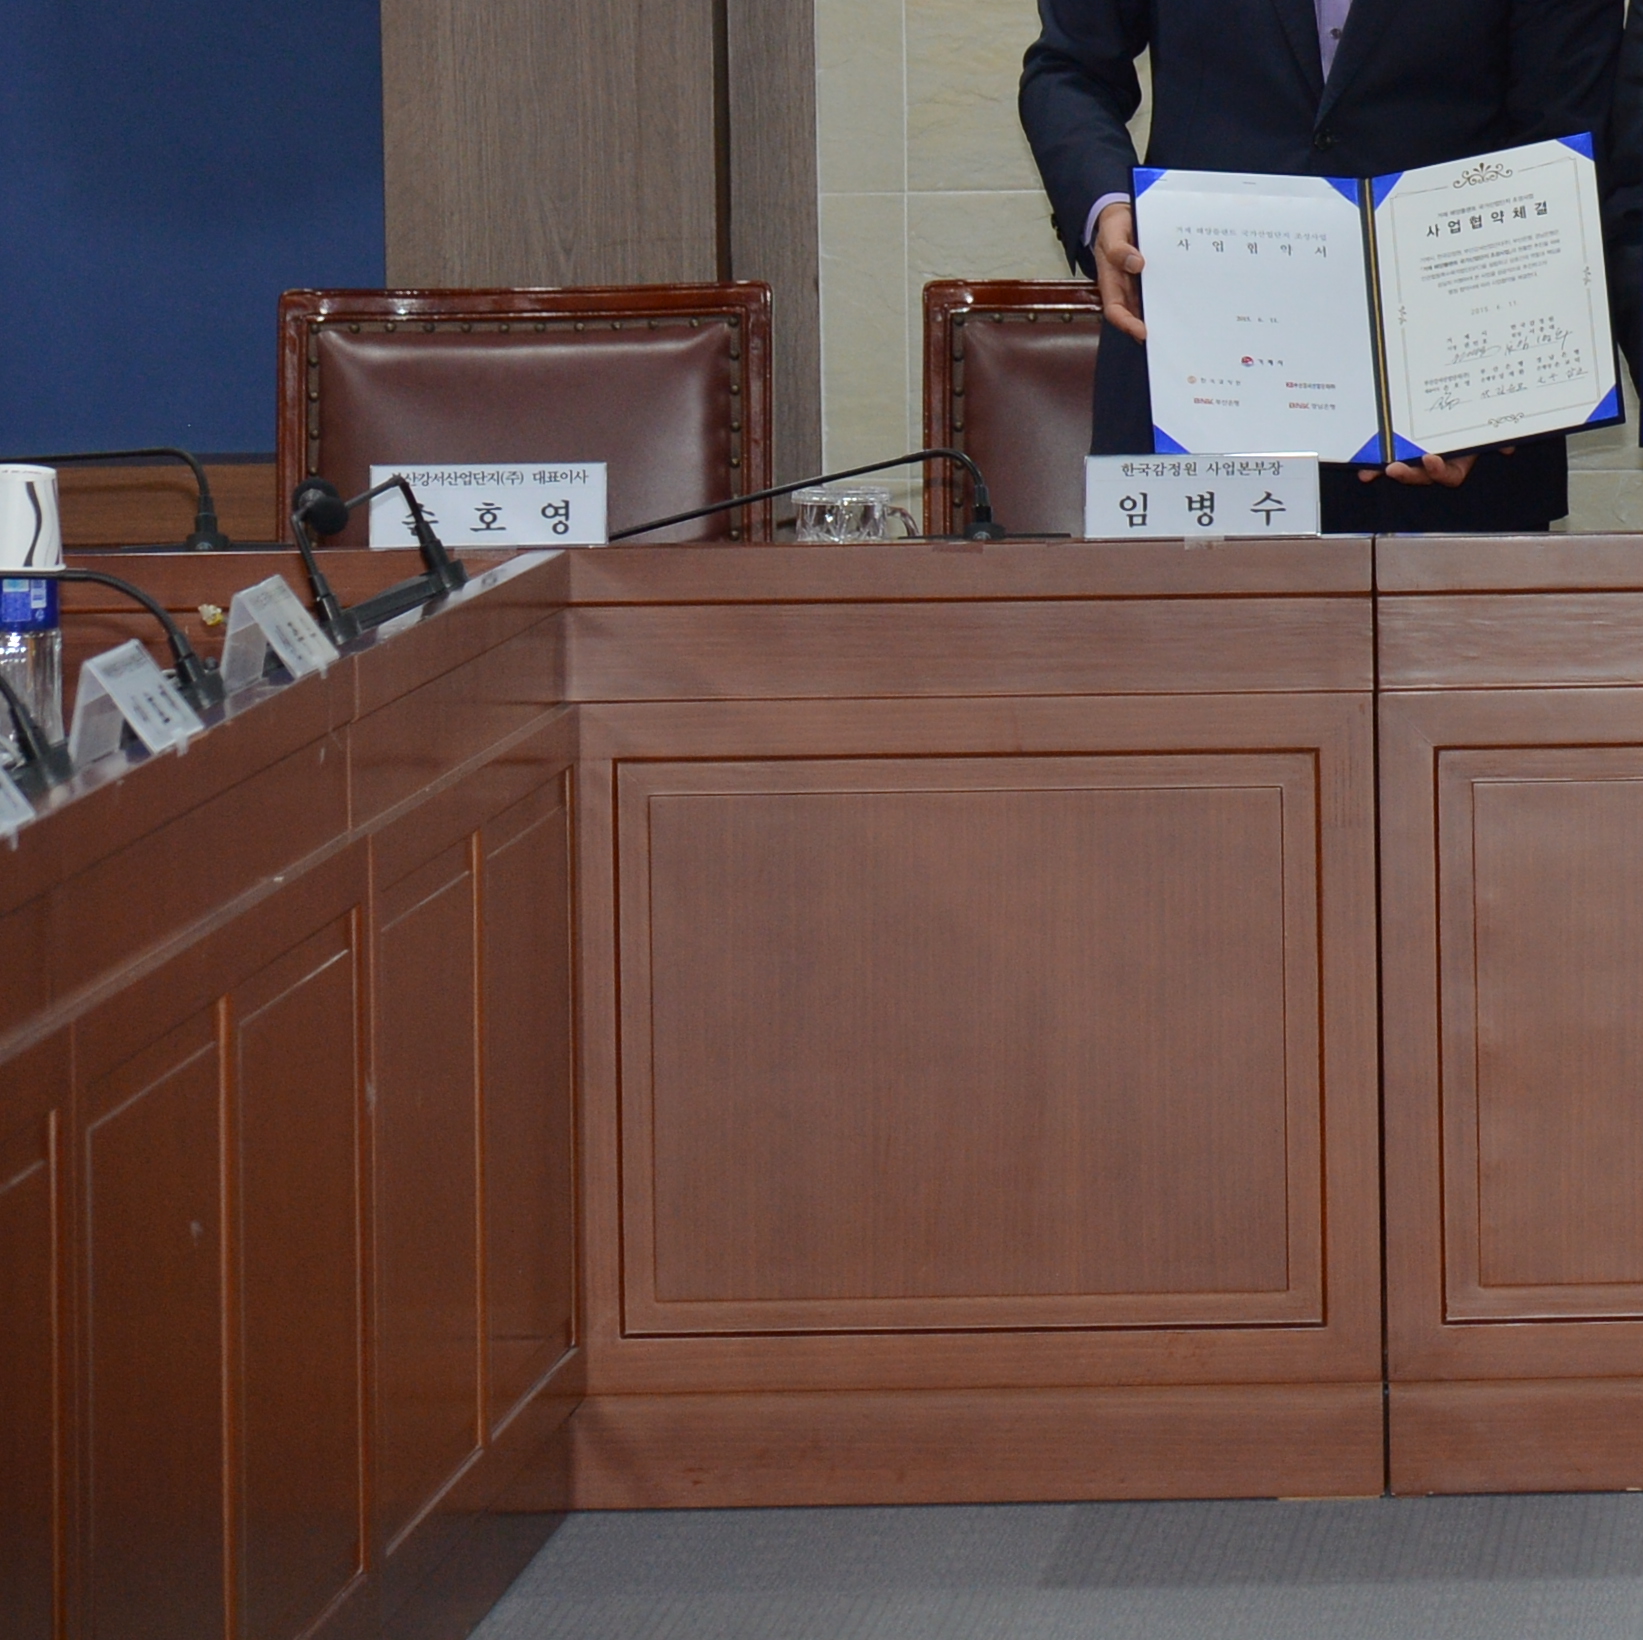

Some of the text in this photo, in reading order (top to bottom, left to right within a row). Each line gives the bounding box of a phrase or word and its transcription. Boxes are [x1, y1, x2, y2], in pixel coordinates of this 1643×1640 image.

[1121, 460, 1284, 477] 한국감정원 사업본부장
[394, 469, 589, 487] 산강서산업단지(주) 대표이사
